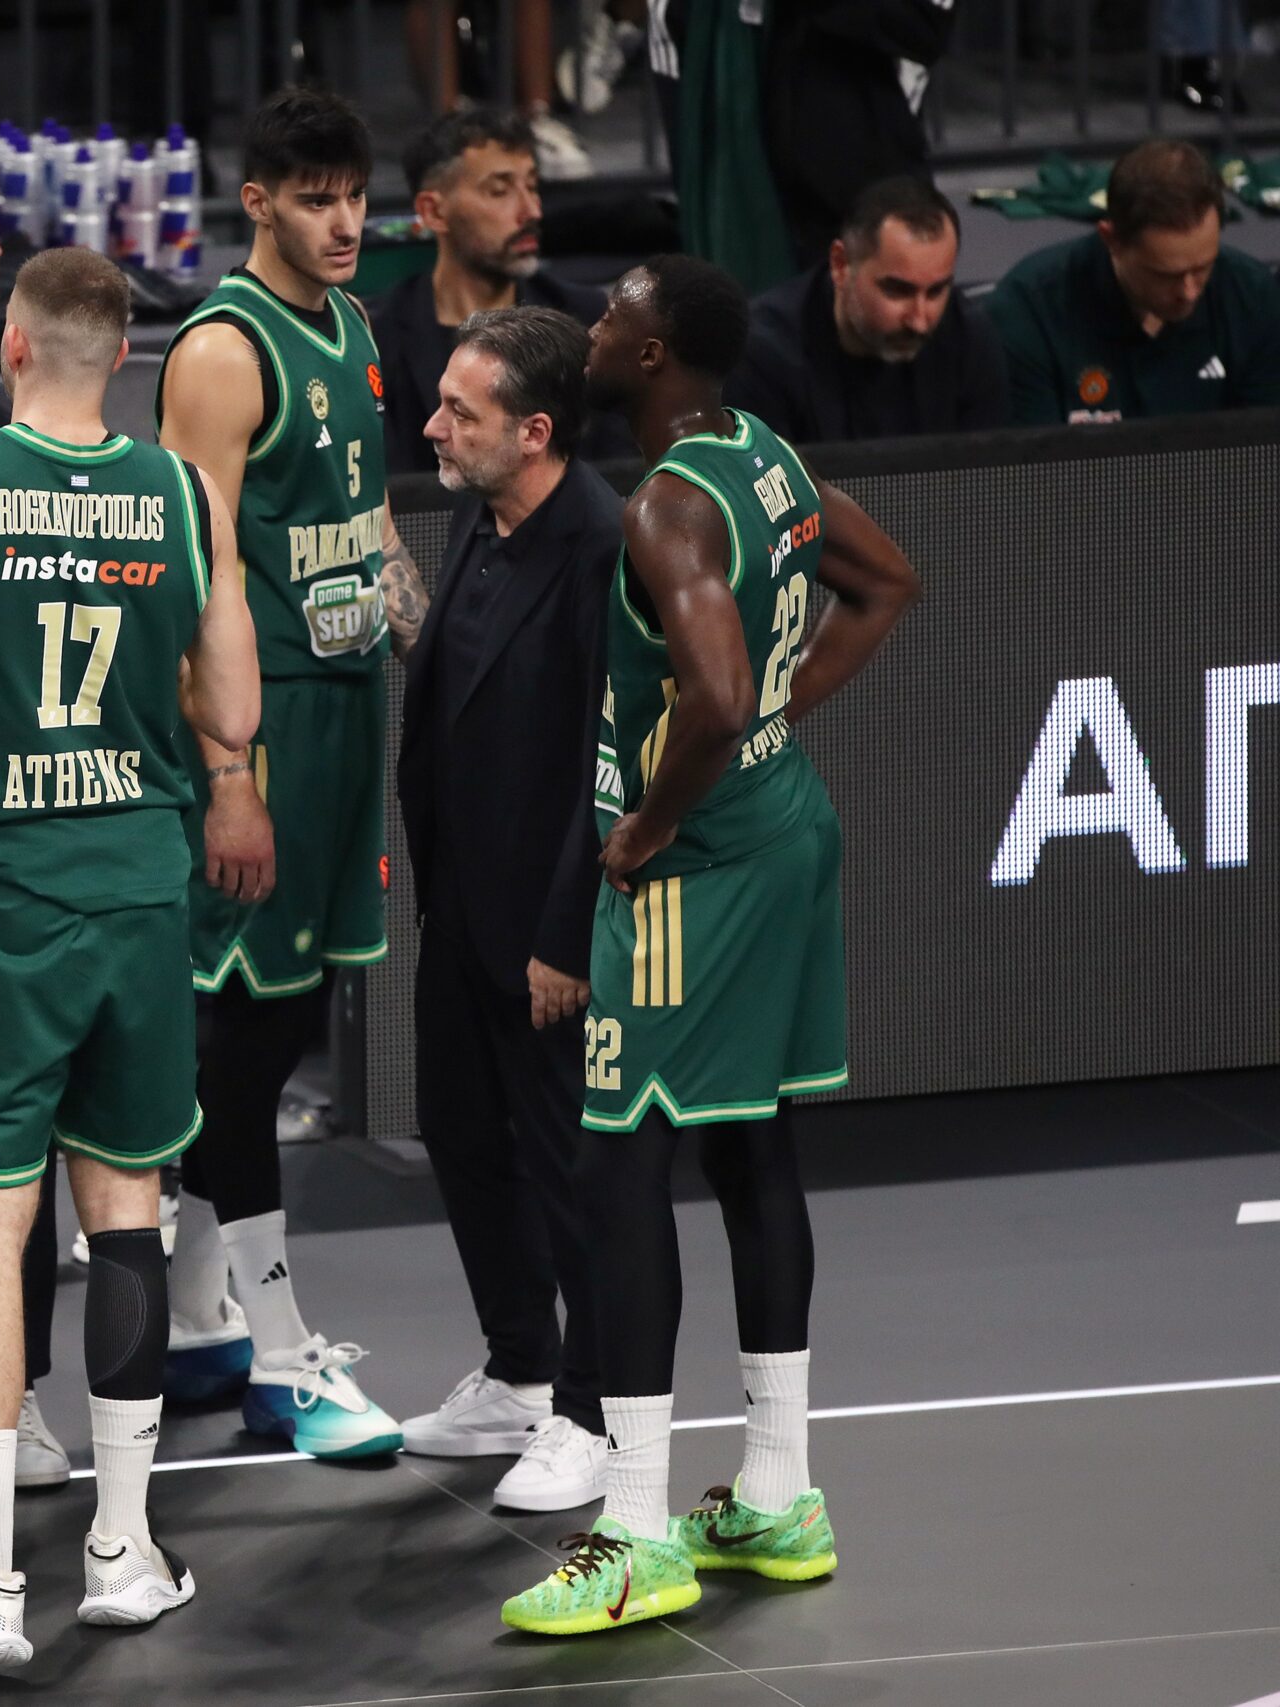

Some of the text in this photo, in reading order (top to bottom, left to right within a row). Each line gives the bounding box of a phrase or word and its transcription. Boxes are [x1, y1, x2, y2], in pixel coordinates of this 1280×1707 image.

[347, 439, 362, 498] 5
[1, 546, 166, 586] instacar
[316, 584, 353, 605] pame
[37, 602, 122, 729] 17
[759, 571, 808, 718] 22
[2, 748, 143, 809] ATHENS
[584, 1015, 622, 1090] 22
